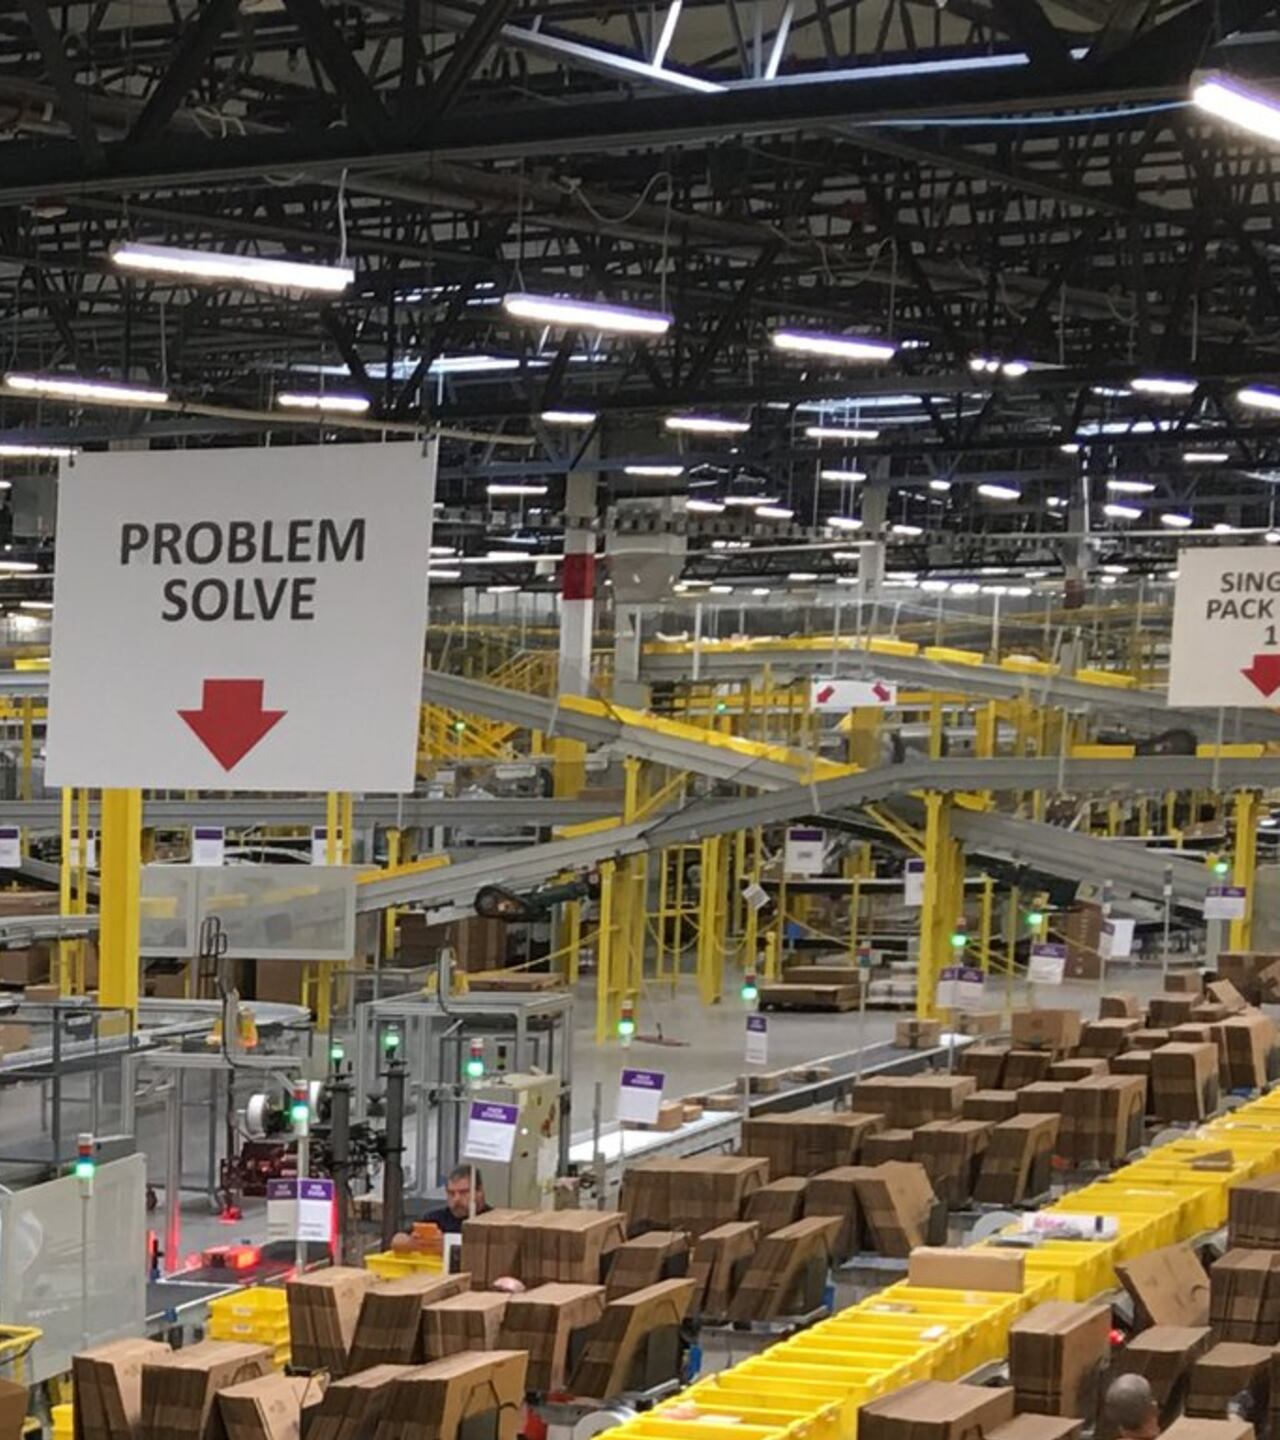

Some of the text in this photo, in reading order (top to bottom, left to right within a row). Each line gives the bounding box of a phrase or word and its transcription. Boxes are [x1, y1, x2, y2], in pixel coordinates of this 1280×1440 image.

[120, 518, 366, 565] PROBLEM
[161, 577, 316, 622] SOLVE
[1206, 599, 1274, 620] PACK
[1265, 625, 1278, 645] 1
